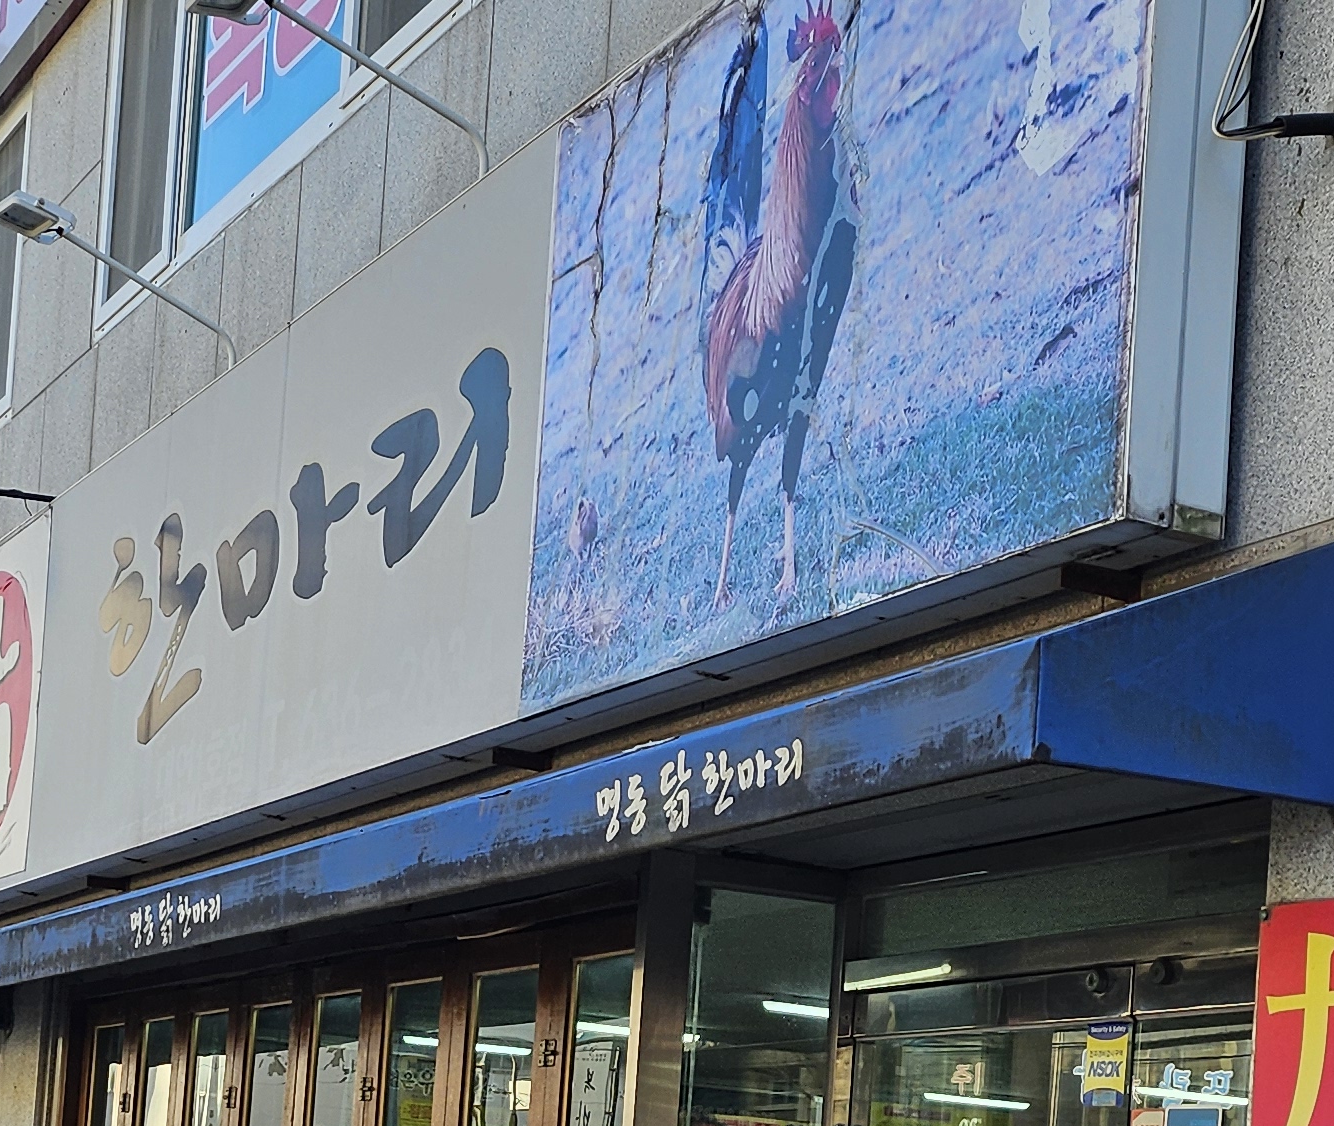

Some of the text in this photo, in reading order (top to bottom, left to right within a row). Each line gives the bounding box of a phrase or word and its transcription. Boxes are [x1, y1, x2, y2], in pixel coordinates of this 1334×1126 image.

[99, 348, 511, 745] 한마리
[596, 737, 805, 841] 명동 닭 한마리
[128, 892, 221, 948] 명동 닭 한마리
[1087, 1061, 1123, 1078] NSOK
